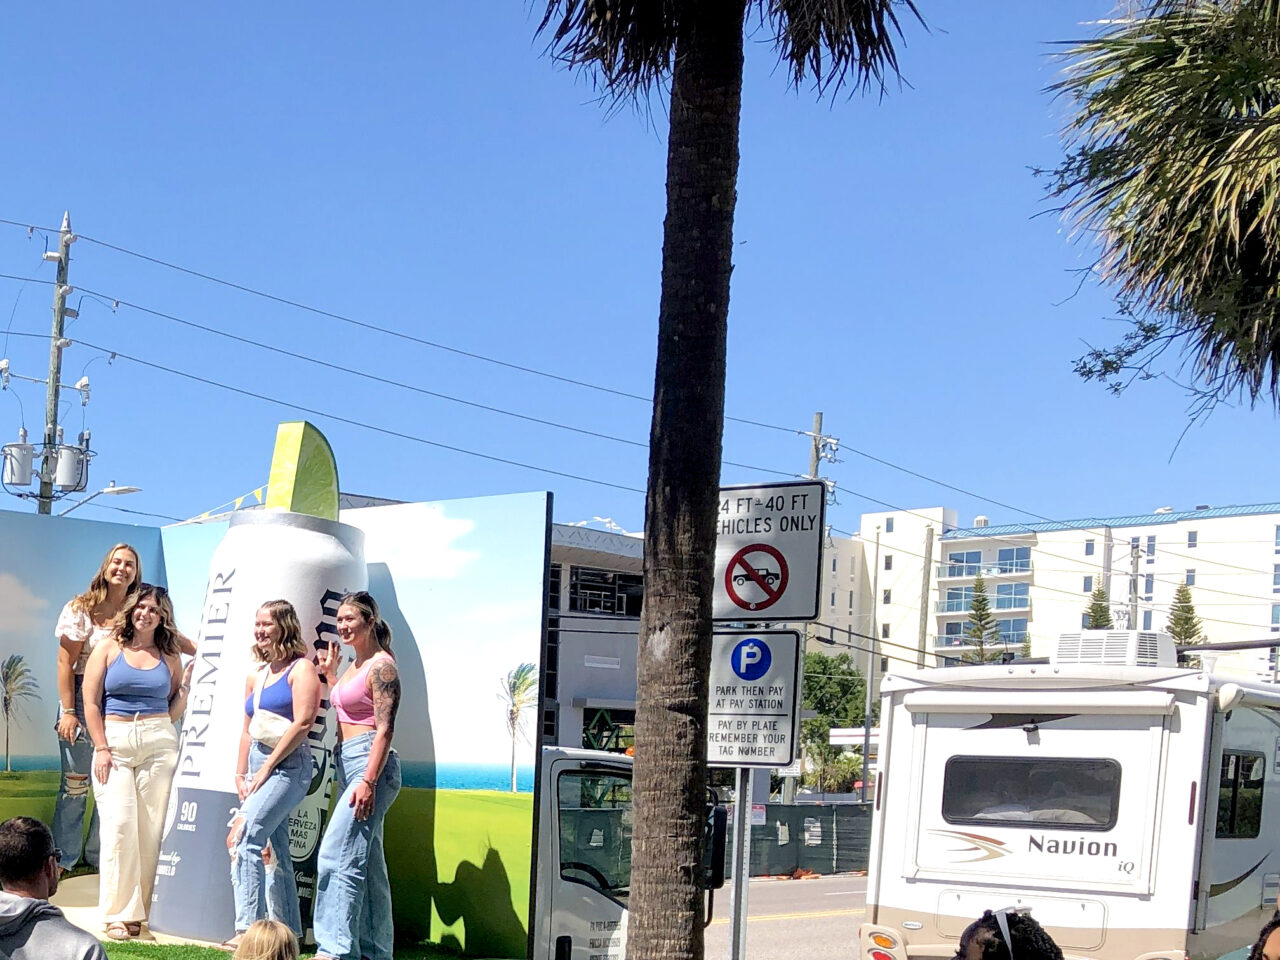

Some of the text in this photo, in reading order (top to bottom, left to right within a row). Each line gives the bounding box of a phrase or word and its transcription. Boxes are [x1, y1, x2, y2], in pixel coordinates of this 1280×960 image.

[718, 498, 730, 514] 4
[792, 493, 808, 510] FT
[716, 514, 816, 535] HICLES ONLY
[740, 646, 762, 673] P
[181, 567, 236, 777] PREMIER
[715, 686, 784, 696] PARK THEN PAY
[716, 699, 783, 709] AT PAY STATION
[718, 721, 778, 731] PAY BY PLATE
[709, 733, 786, 744] REMEMBER YOUR
[719, 746, 775, 757] TAG NUMBER
[180, 801, 198, 823] 90
[297, 809, 309, 819] LA
[288, 818, 317, 831] ERVEZA
[290, 829, 308, 840] MAS
[288, 838, 307, 850] FINA
[1028, 835, 1118, 857] Navion
[1118, 860, 1136, 875] iQ
